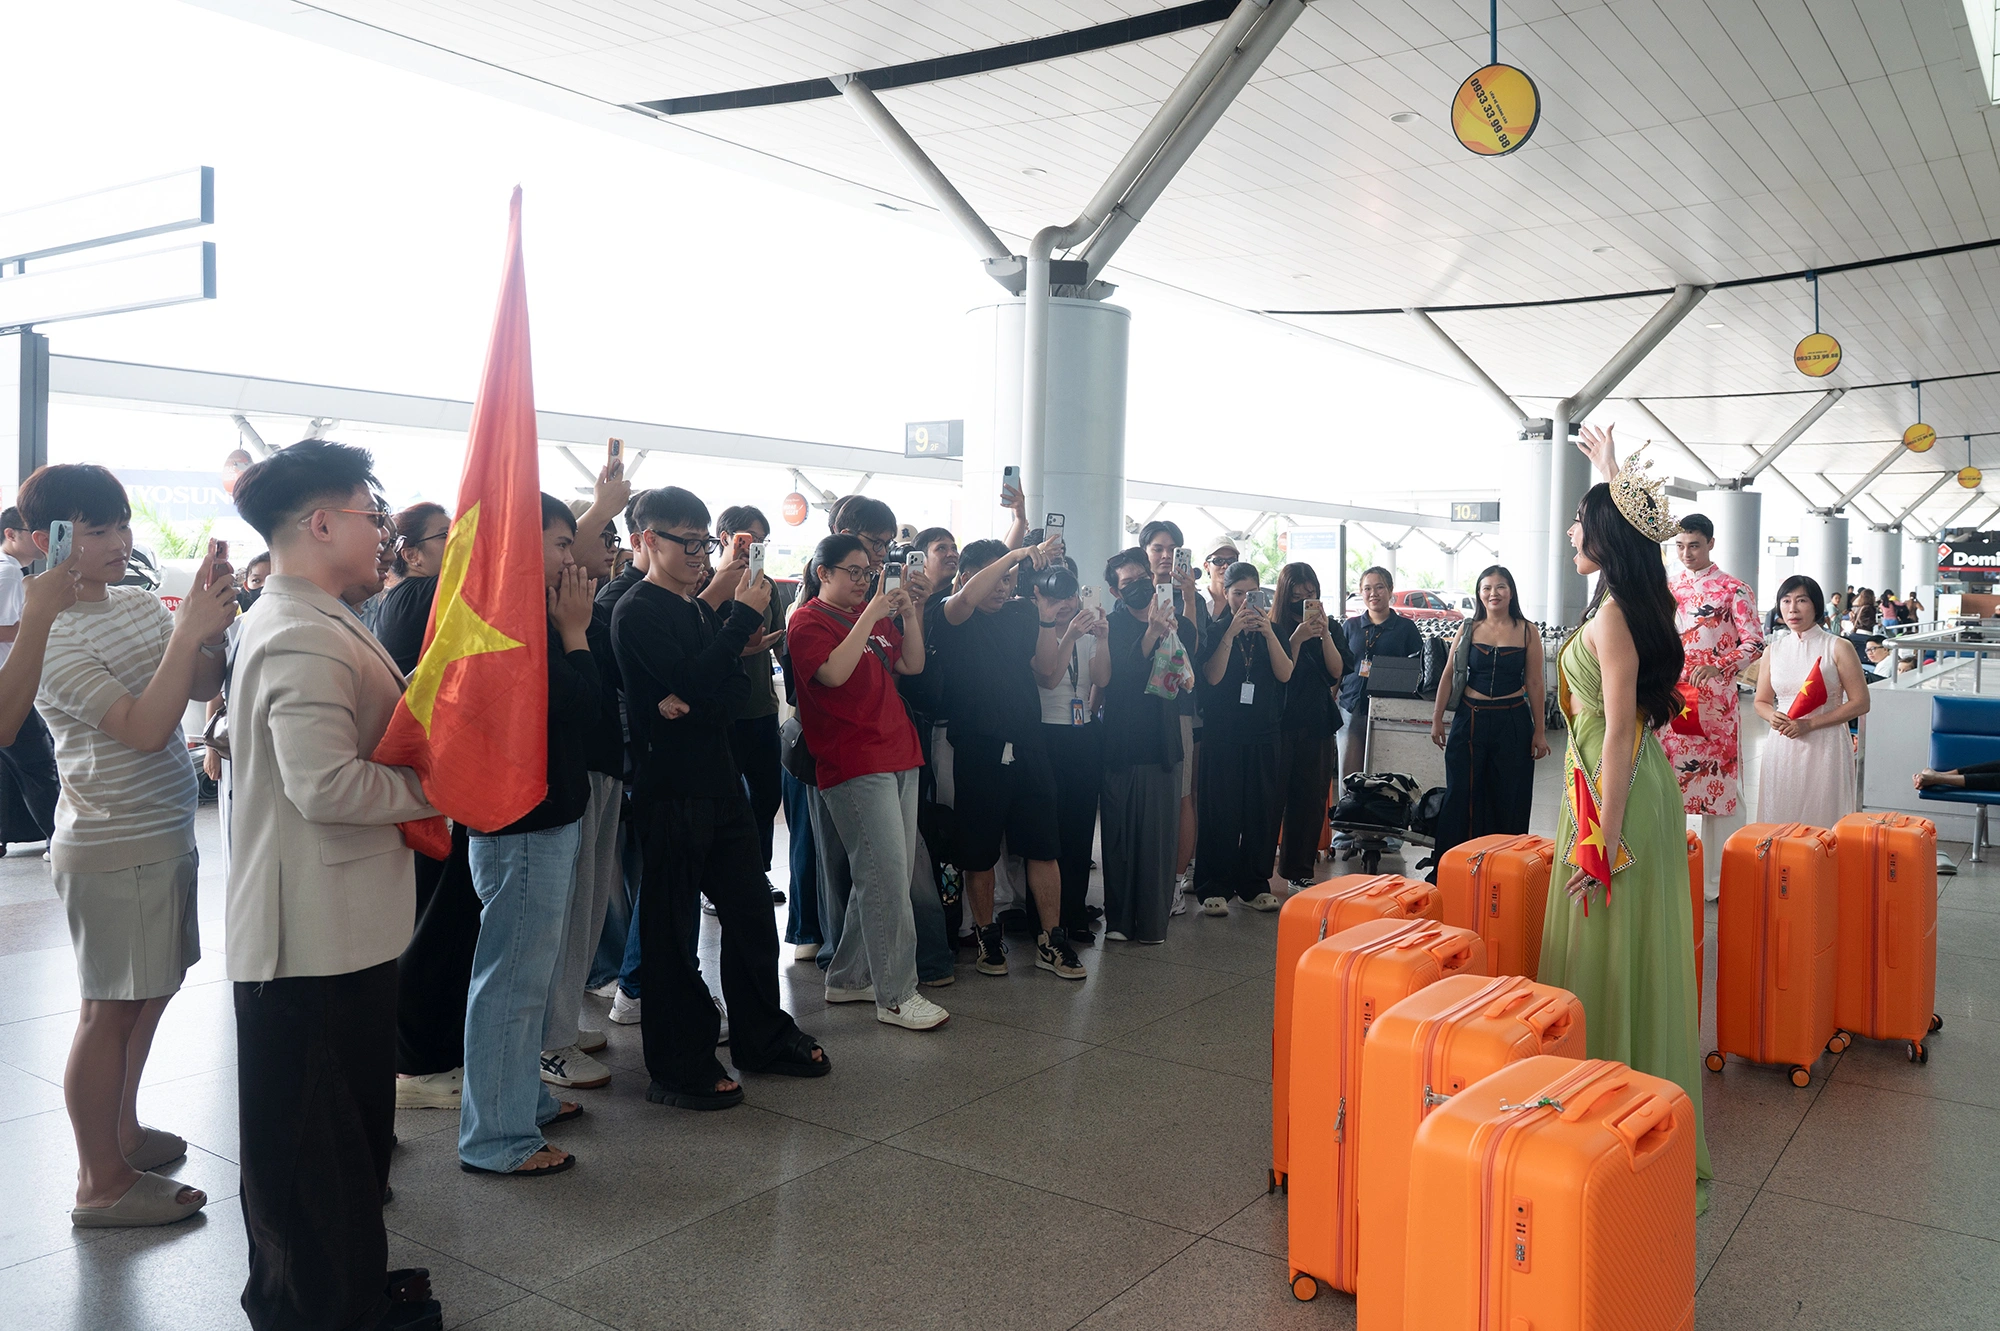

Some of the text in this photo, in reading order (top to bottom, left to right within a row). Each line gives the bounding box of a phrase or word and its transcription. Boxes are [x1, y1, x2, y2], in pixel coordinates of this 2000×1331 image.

[1470, 78, 1511, 148] 0933.33.99.88
[915, 426, 940, 452] 9 2F
[125, 484, 235, 505] YOSUN
[1454, 504, 1471, 520] 10
